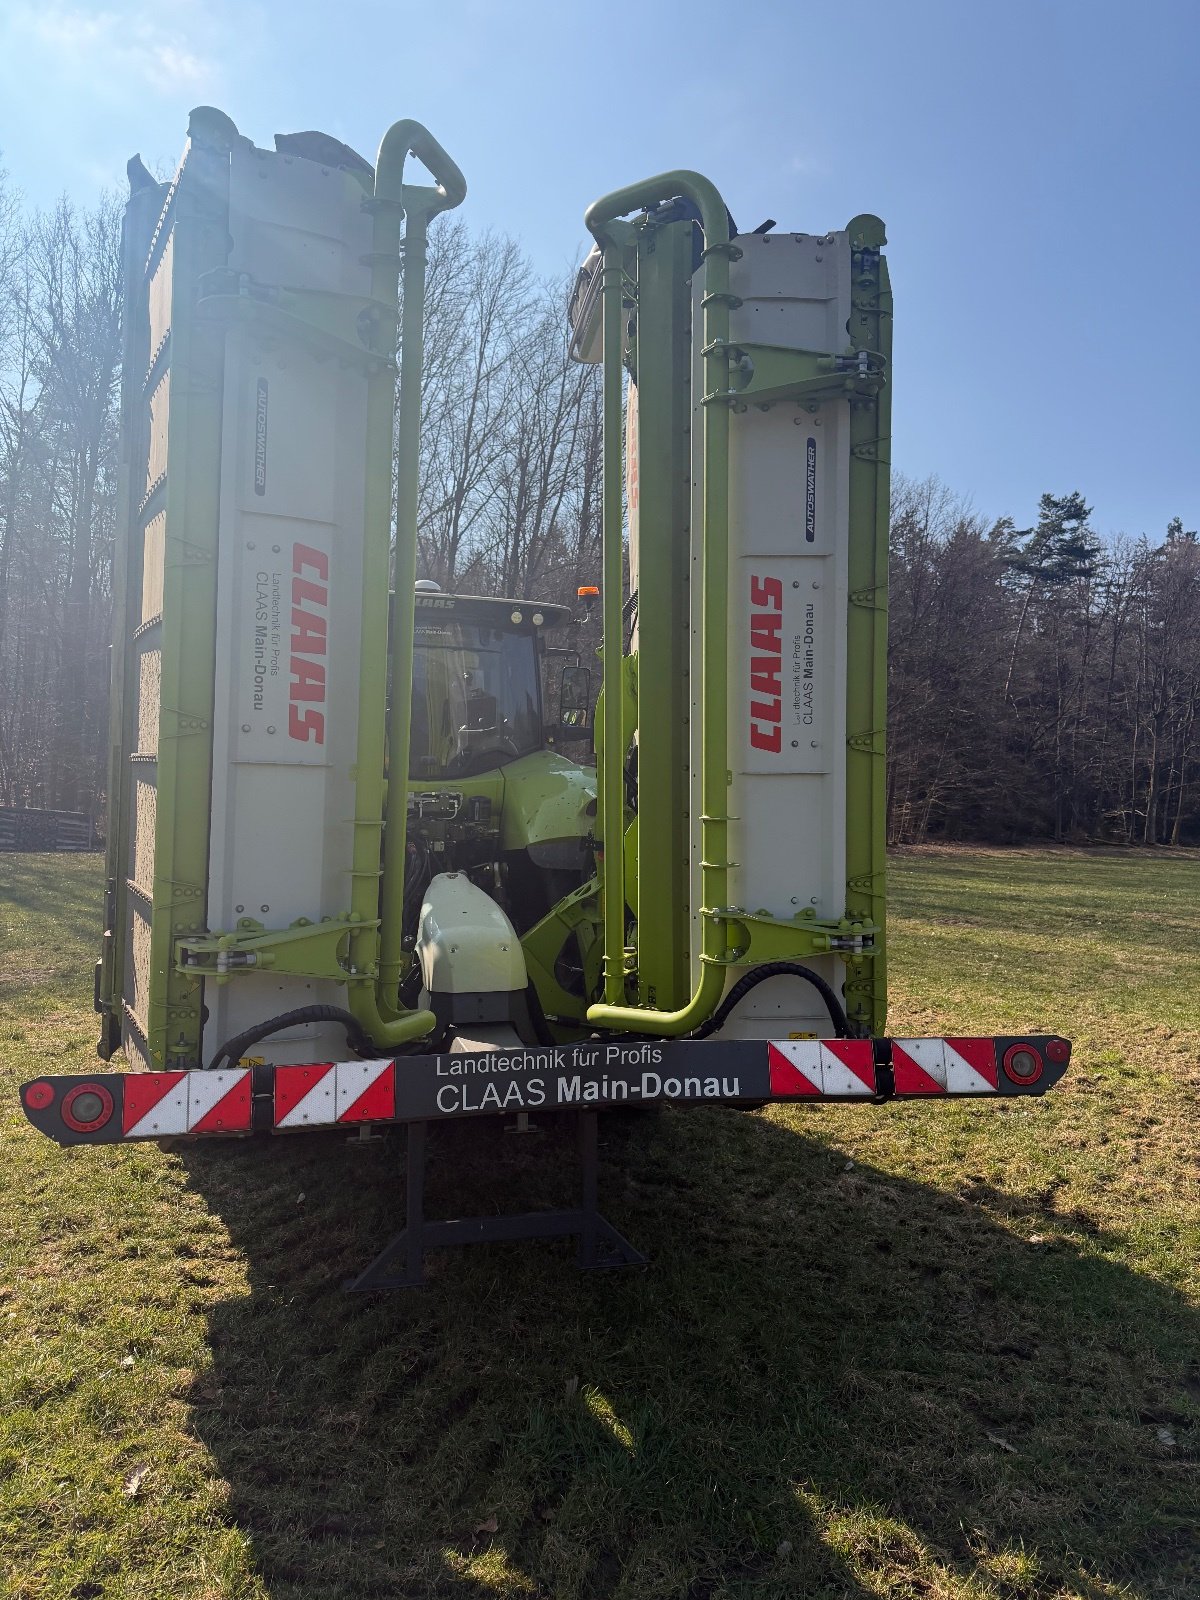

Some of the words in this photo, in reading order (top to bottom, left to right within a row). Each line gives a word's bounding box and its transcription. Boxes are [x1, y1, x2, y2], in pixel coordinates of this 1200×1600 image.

[255, 387, 267, 487] AUTOSWATHER
[806, 446, 816, 533] AUTOSWATHER
[256, 571, 269, 621] CLAAS
[271, 572, 282, 631] Landtechnik
[415, 597, 456, 609] LAAS
[270, 649, 281, 676] Profis
[271, 633, 281, 646] für
[288, 542, 329, 745] CLAAS
[792, 634, 801, 659] Profis
[803, 603, 814, 679] Main-Donau
[253, 625, 268, 711] Main-Donau
[750, 575, 783, 754] CLAAS
[792, 660, 801, 673] für
[802, 682, 814, 726] CLAAS
[436, 1049, 566, 1076] Landtechnik
[572, 1048, 600, 1067] für
[606, 1045, 663, 1065] Profis
[436, 1078, 546, 1113] CLAAS
[557, 1072, 741, 1103] Main-Donau
